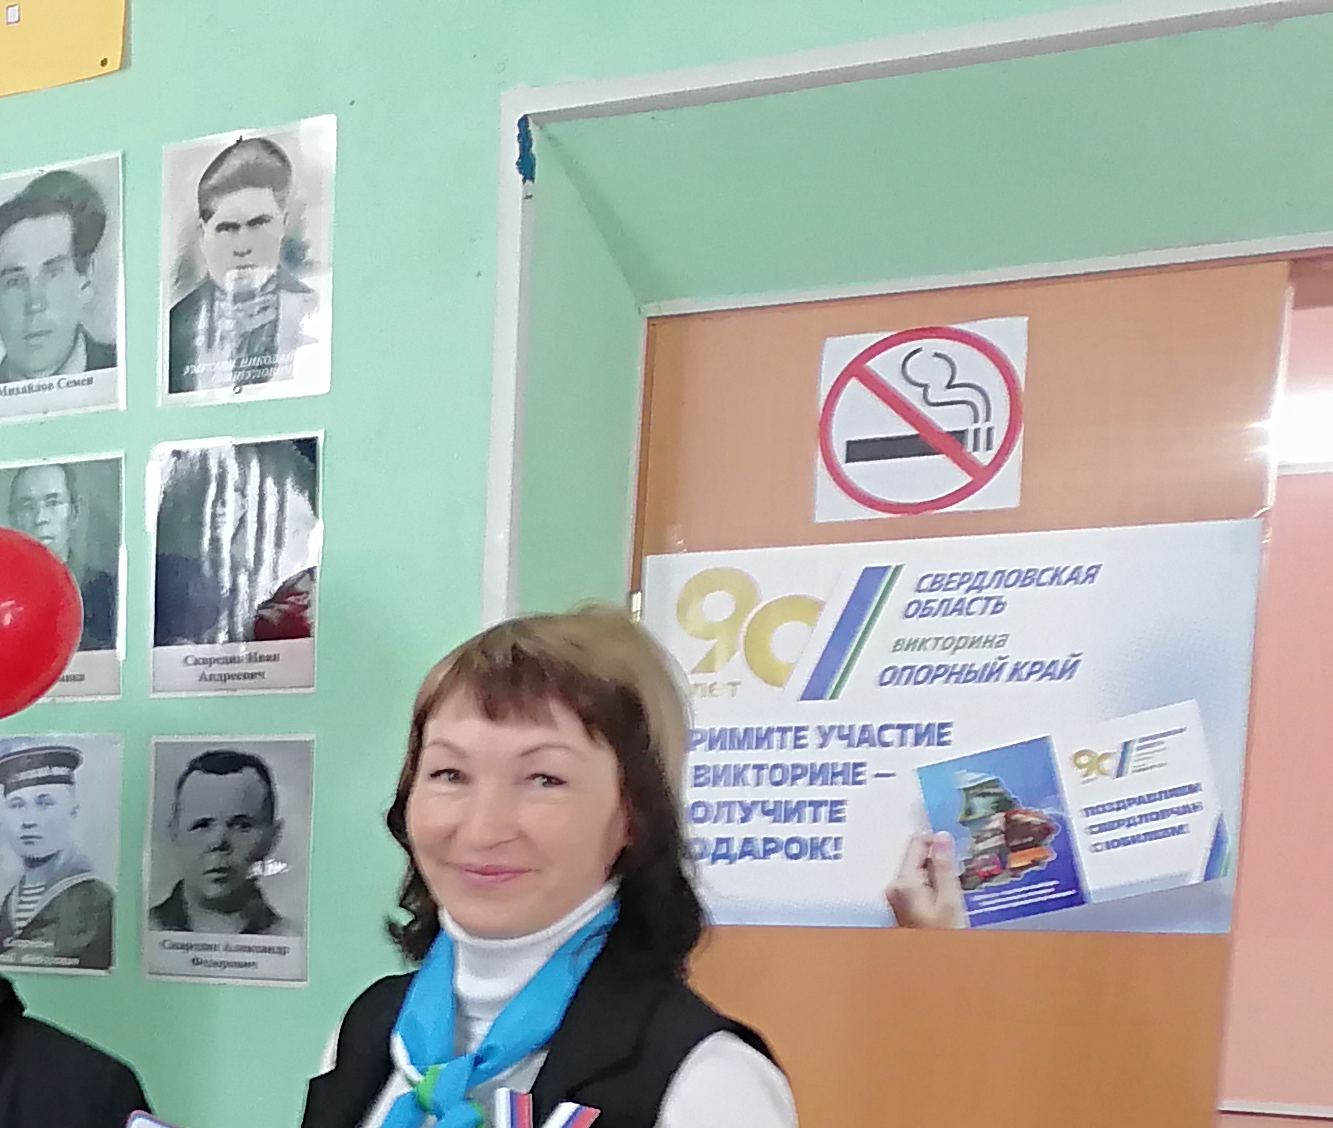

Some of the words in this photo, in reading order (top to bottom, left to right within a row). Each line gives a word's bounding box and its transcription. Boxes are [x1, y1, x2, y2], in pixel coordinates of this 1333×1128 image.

[915, 564, 1103, 594] СВЕРДЛОВСКАЯ
[904, 595, 1007, 619] ОБЛАСТЬ
[892, 634, 1010, 655] викторина
[879, 655, 1009, 686] ОПОРНЫЙ
[1007, 653, 1083, 682] КРАЙ
[688, 726, 809, 750] РИМИТЕ
[816, 721, 953, 749] УЧАСТИЕ
[693, 761, 867, 787] ВИКТОРИНЕ
[690, 799, 848, 824] ОЛУЧИТЕ
